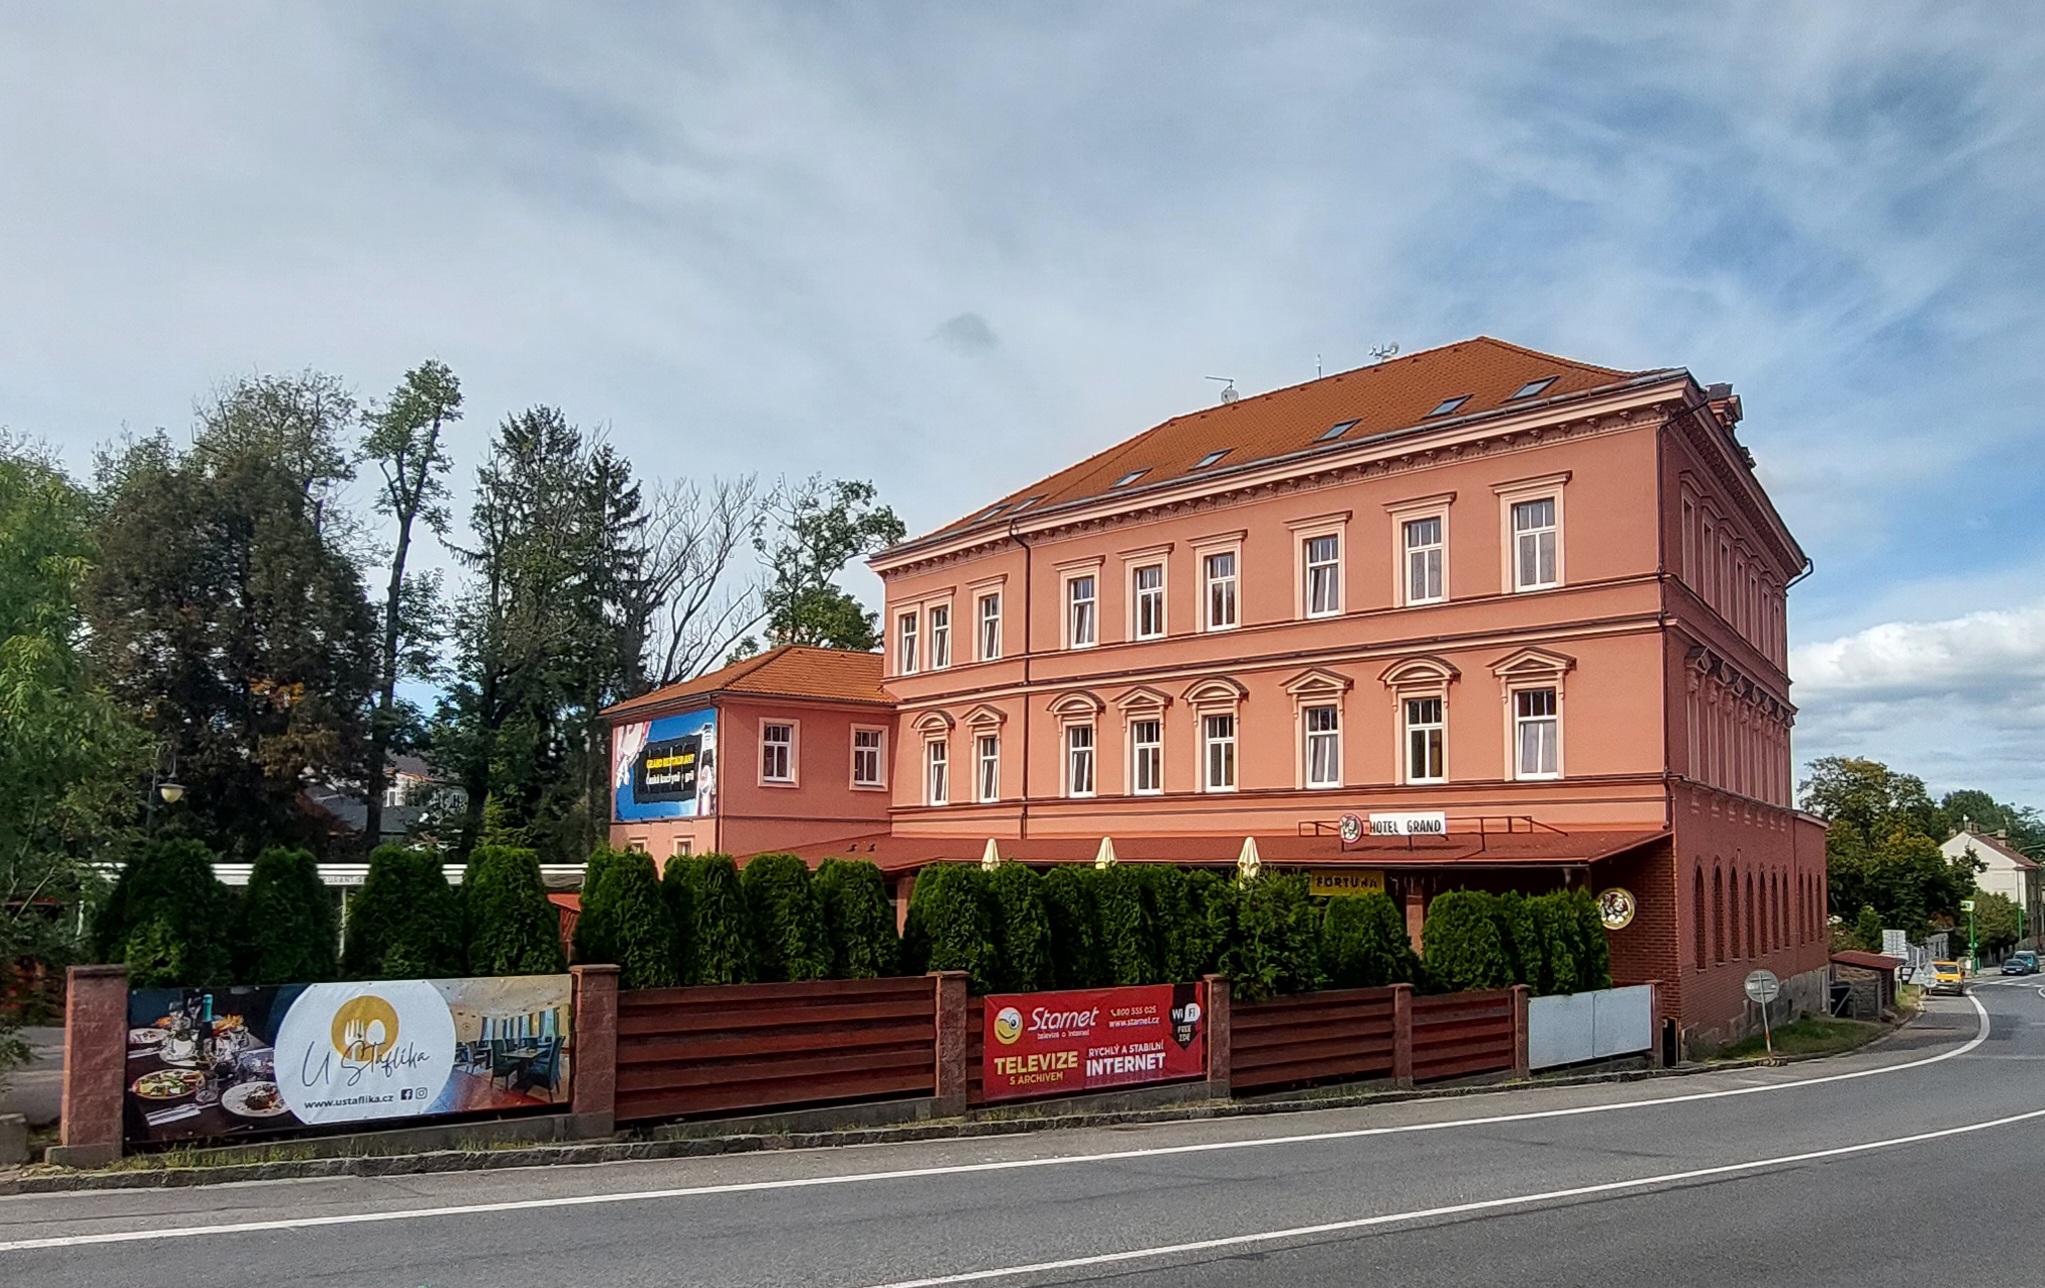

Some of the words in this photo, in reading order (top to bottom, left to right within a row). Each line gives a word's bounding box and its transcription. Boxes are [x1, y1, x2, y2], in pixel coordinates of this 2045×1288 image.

[1370, 820, 1399, 833] HOTEL
[1406, 819, 1442, 833] GRAND
[1316, 877, 1377, 888] FORTUNA
[1027, 1006, 1099, 1031] Starnet
[1088, 1043, 1120, 1057] RYCHLÝ
[1121, 1046, 1127, 1054] A
[1129, 1039, 1165, 1053] STABILNÍ
[302, 1040, 331, 1087] U
[994, 1051, 1079, 1076] TELEVIZE
[1085, 1052, 1166, 1077] INTERNET
[1009, 1076, 1016, 1085] S
[1017, 1071, 1064, 1085] ARCHIVEM
[304, 1094, 394, 1109] www.ustaflika.cz
